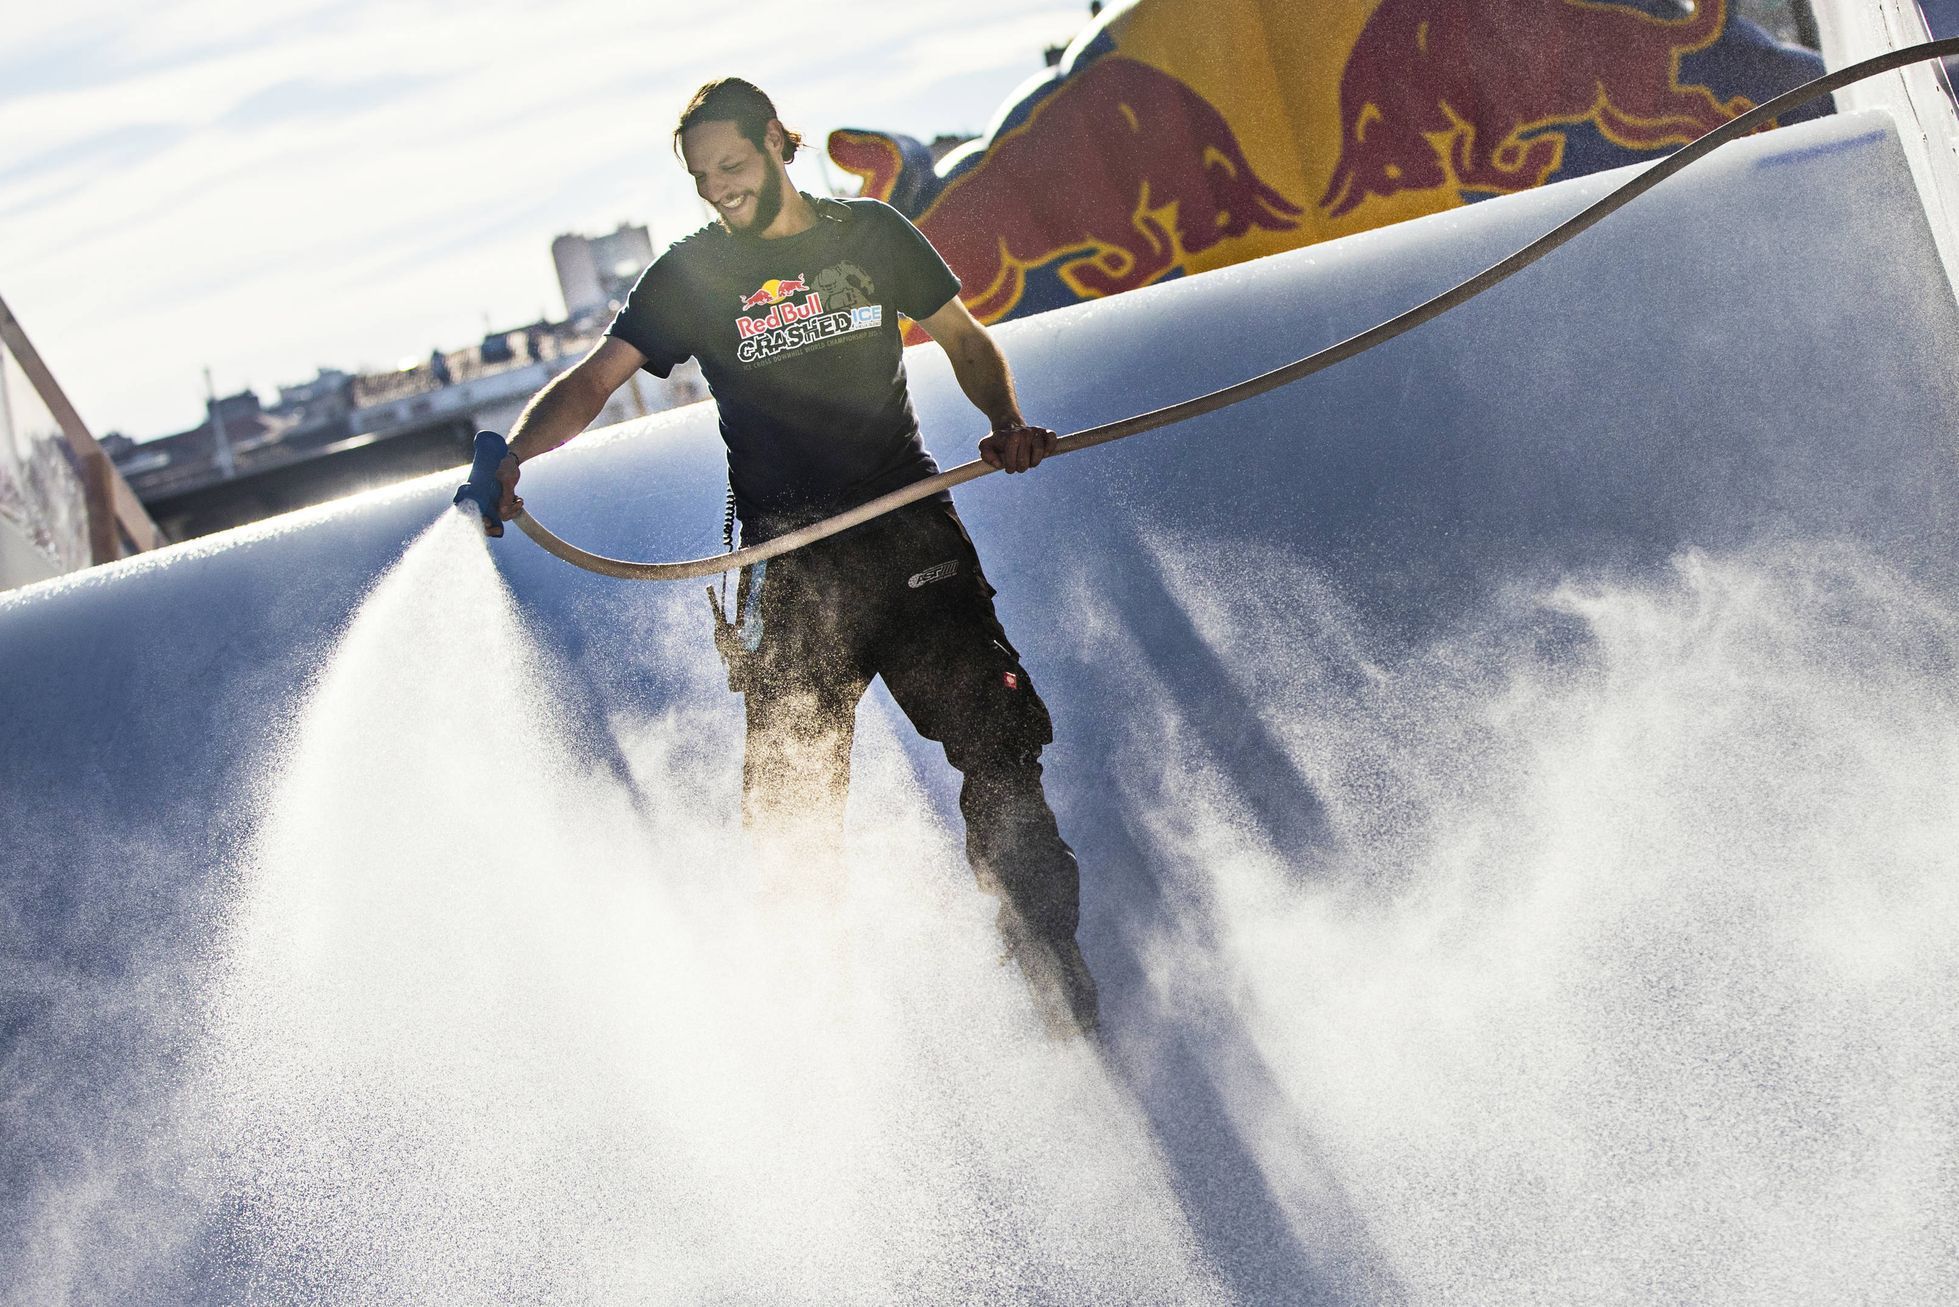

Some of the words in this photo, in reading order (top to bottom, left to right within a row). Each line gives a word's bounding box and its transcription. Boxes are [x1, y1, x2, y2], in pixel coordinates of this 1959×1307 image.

[736, 305, 782, 339] Red
[779, 292, 823, 325] Bull
[737, 311, 852, 362] CRASHED
[850, 305, 882, 323] ICE
